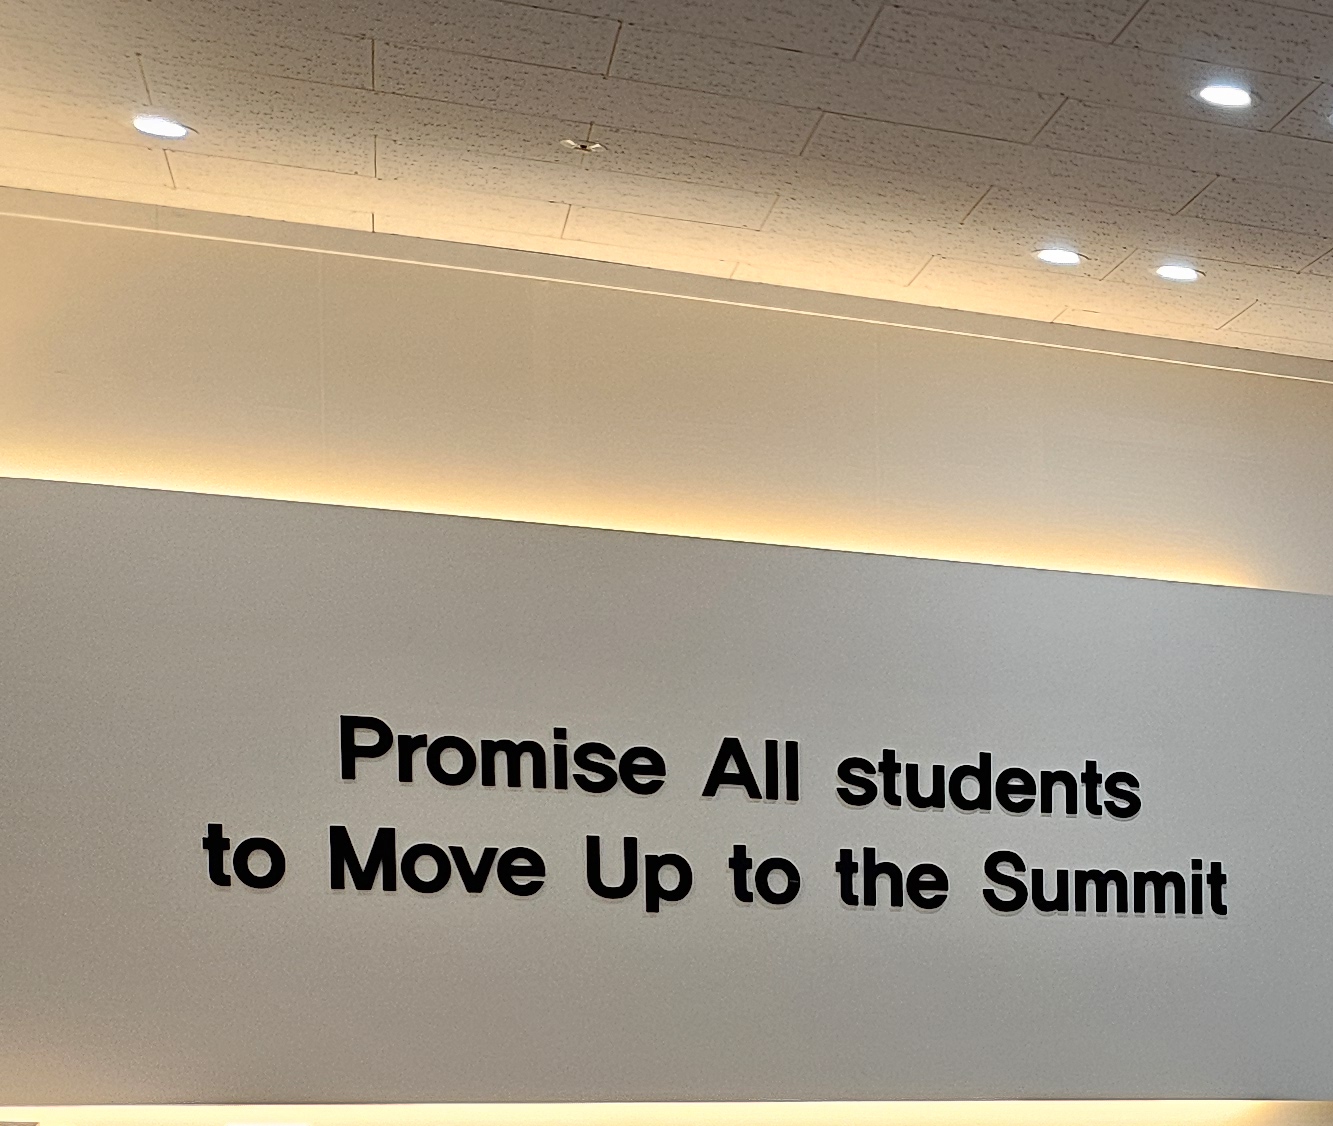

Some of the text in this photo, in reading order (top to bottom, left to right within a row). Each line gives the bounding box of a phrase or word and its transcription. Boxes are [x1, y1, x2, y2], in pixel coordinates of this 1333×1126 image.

[340, 715, 1141, 818] Promise All students
[202, 824, 1227, 915] to Move Up to the Summit
